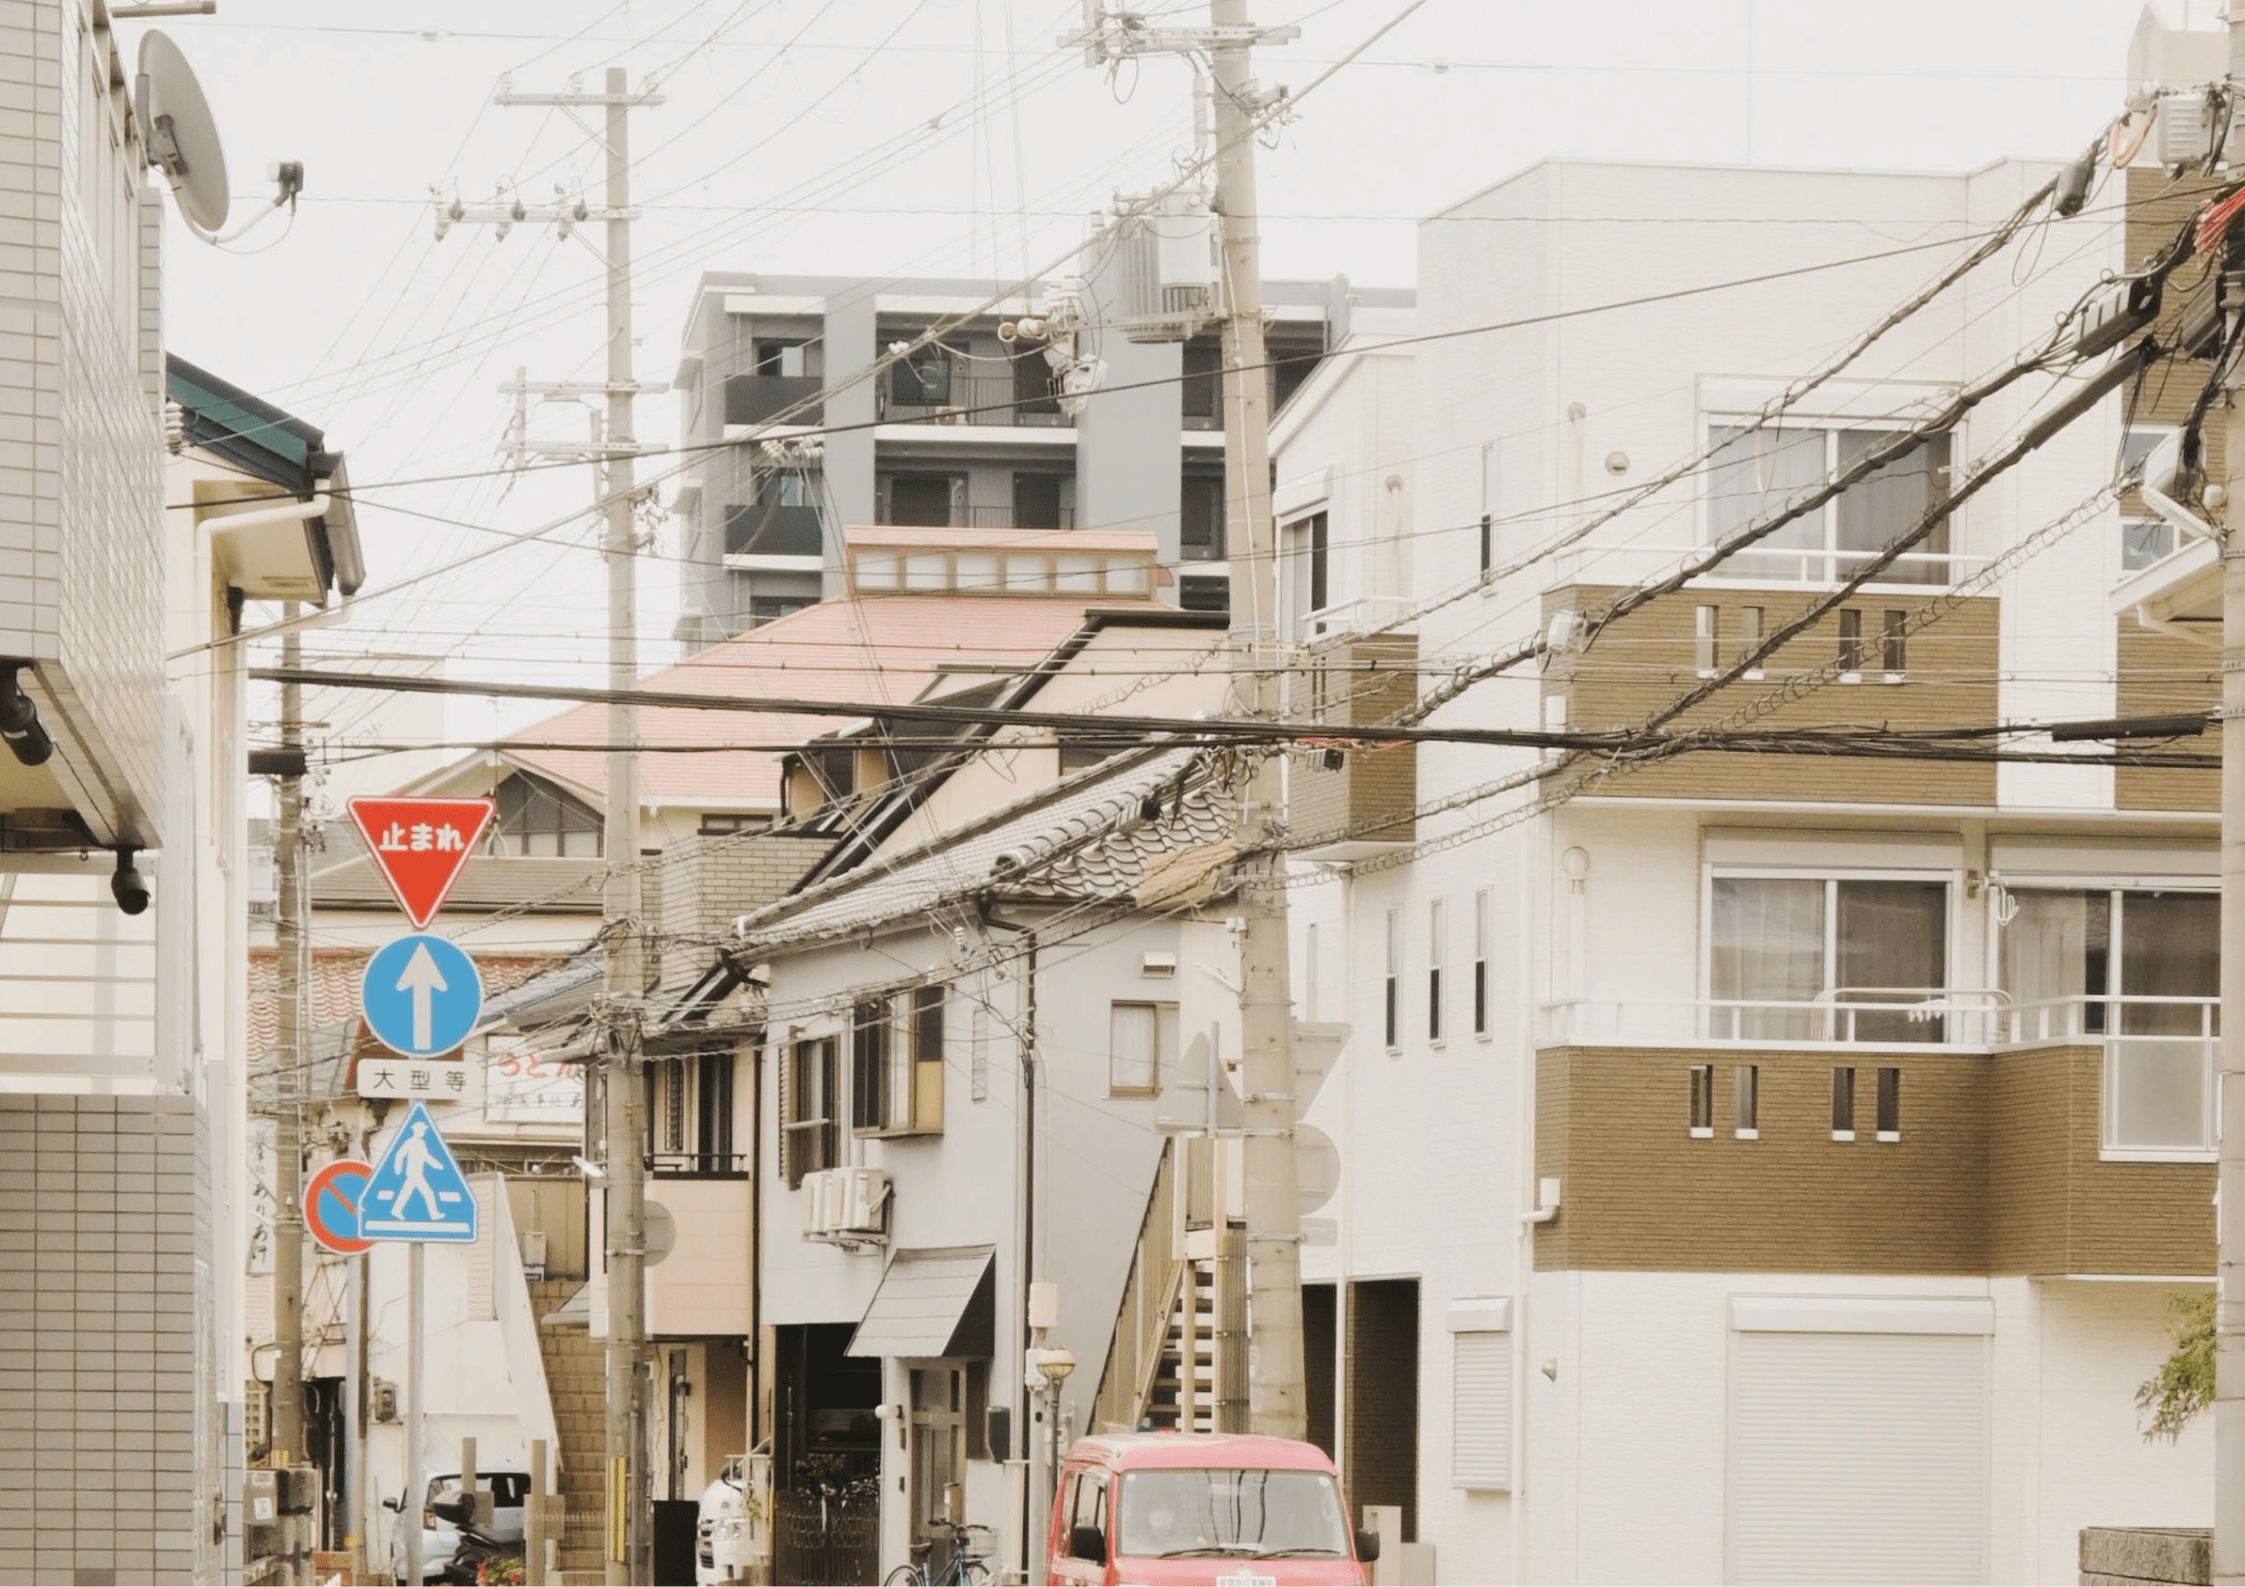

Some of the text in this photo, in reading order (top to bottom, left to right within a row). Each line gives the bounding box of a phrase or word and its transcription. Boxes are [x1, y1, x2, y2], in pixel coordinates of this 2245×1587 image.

[378, 821, 464, 851] 止まれ
[372, 1068, 466, 1092] 大型等
